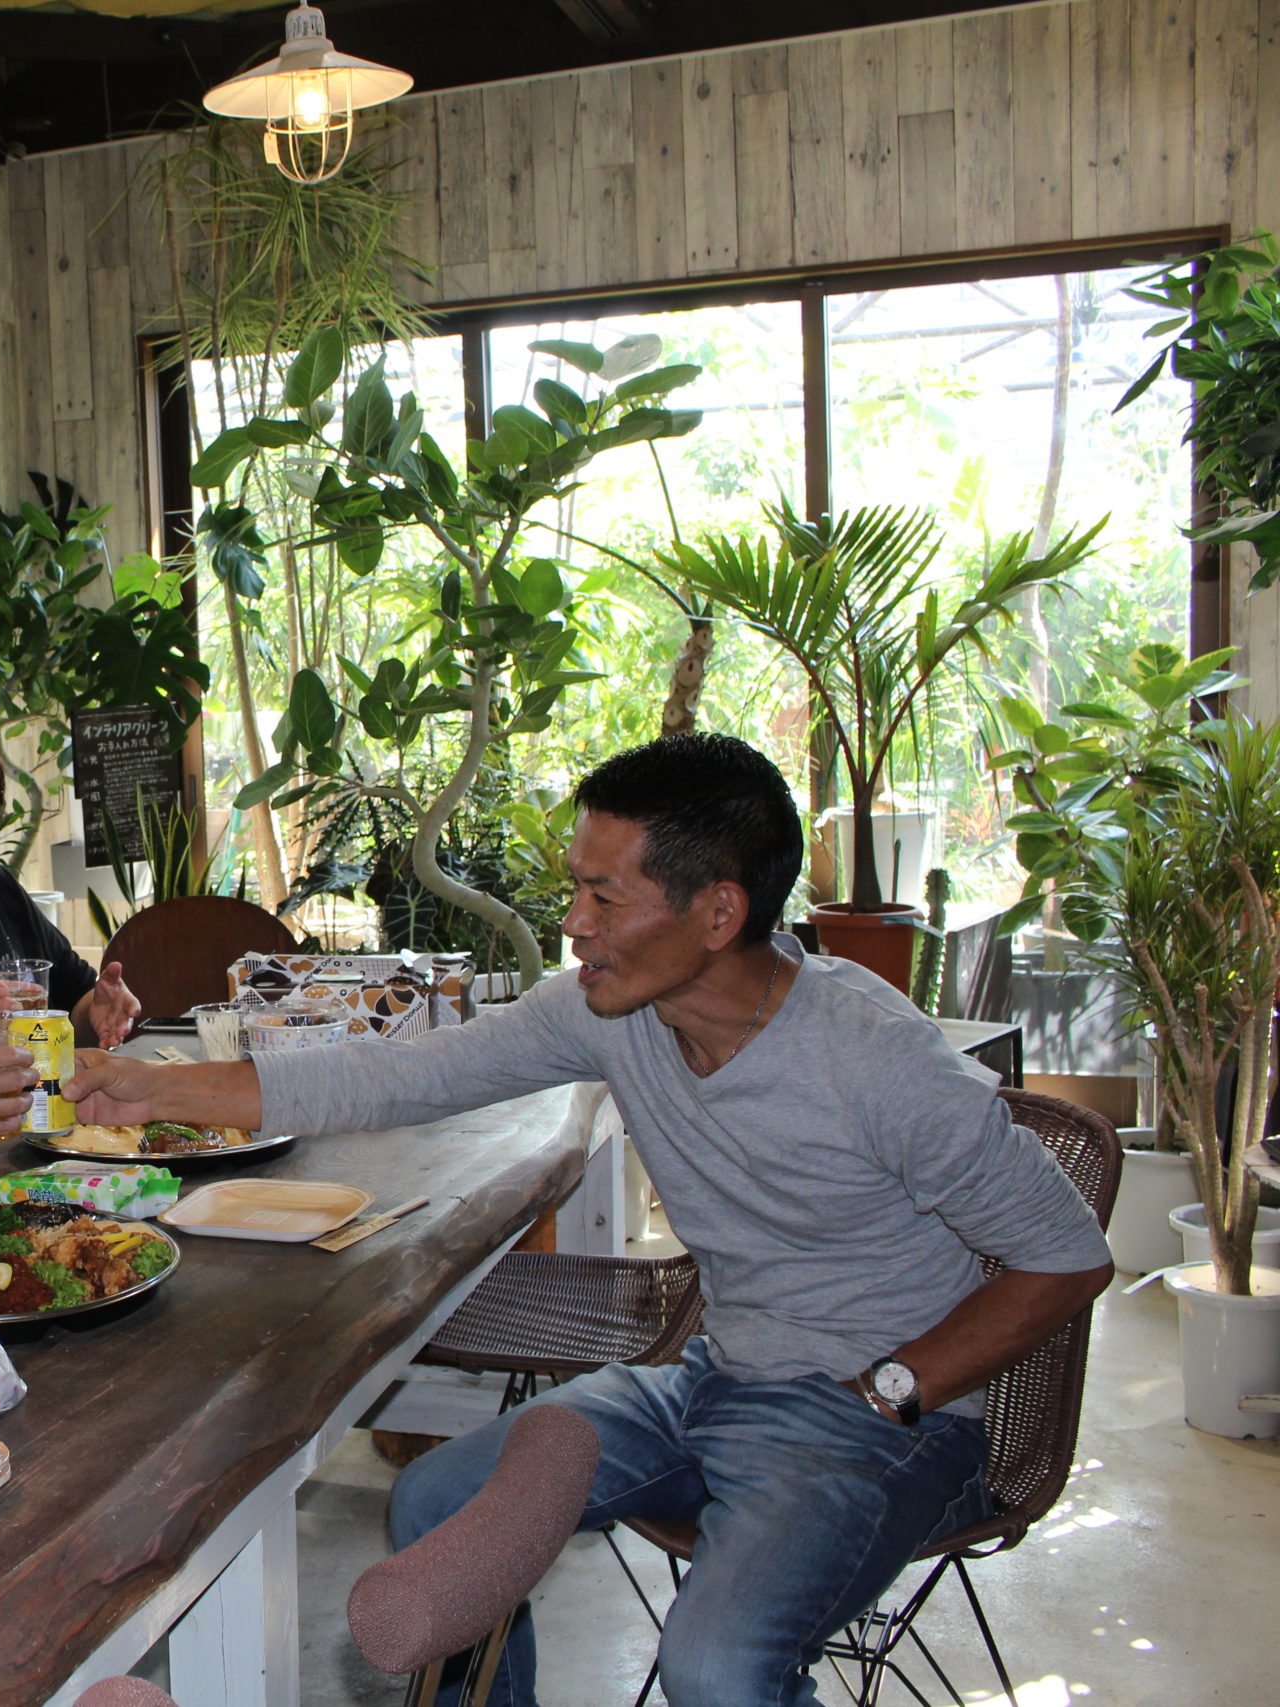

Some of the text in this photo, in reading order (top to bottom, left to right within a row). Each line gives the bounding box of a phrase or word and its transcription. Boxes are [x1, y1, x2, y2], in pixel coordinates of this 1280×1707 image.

[83, 719, 169, 739] インテリアグリーン
